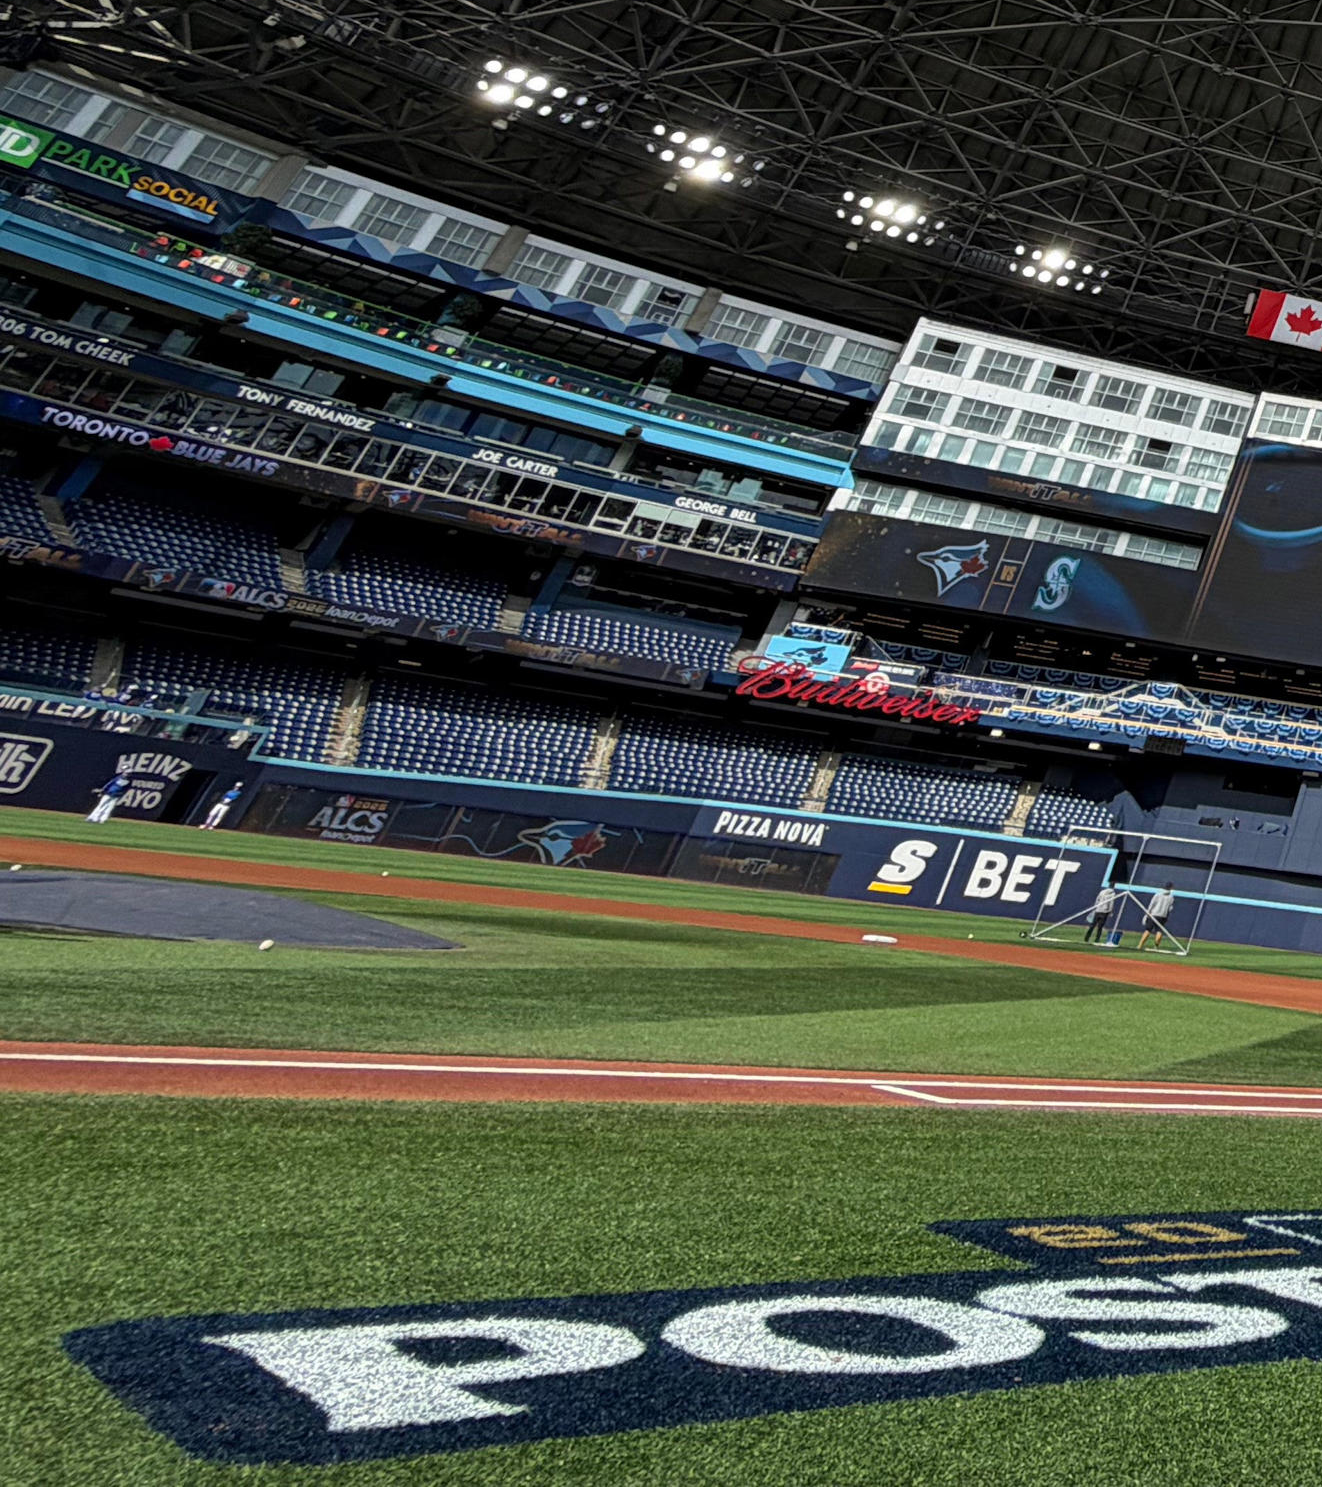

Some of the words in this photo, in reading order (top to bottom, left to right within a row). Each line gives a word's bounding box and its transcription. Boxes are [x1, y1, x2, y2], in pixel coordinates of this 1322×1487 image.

[46, 140, 143, 185] PARK
[133, 176, 219, 215] SOCIAL
[29, 326, 73, 349] TOM
[75, 341, 136, 367] CHEEK
[236, 384, 283, 407] TONY
[286, 399, 376, 433] FERNANDEZ
[41, 406, 150, 447] TORONTO
[171, 439, 225, 465] BLUE
[225, 452, 280, 478] JAYS
[472, 447, 504, 463] JOE
[506, 456, 559, 479] CARTER
[675, 496, 728, 516] GEORGE
[729, 504, 757, 524] BELL
[999, 564, 1018, 583] VS
[231, 585, 288, 610] ALCS
[734, 655, 982, 725] Budweiser
[115, 752, 193, 782] HEINZ
[116, 789, 162, 810] AYO
[307, 806, 389, 834] ALCS
[713, 811, 772, 839] PIZZA
[773, 820, 826, 847] NOVA
[876, 839, 938, 884] S
[963, 849, 1081, 907] BET
[1007, 1220, 1242, 1249] 20
